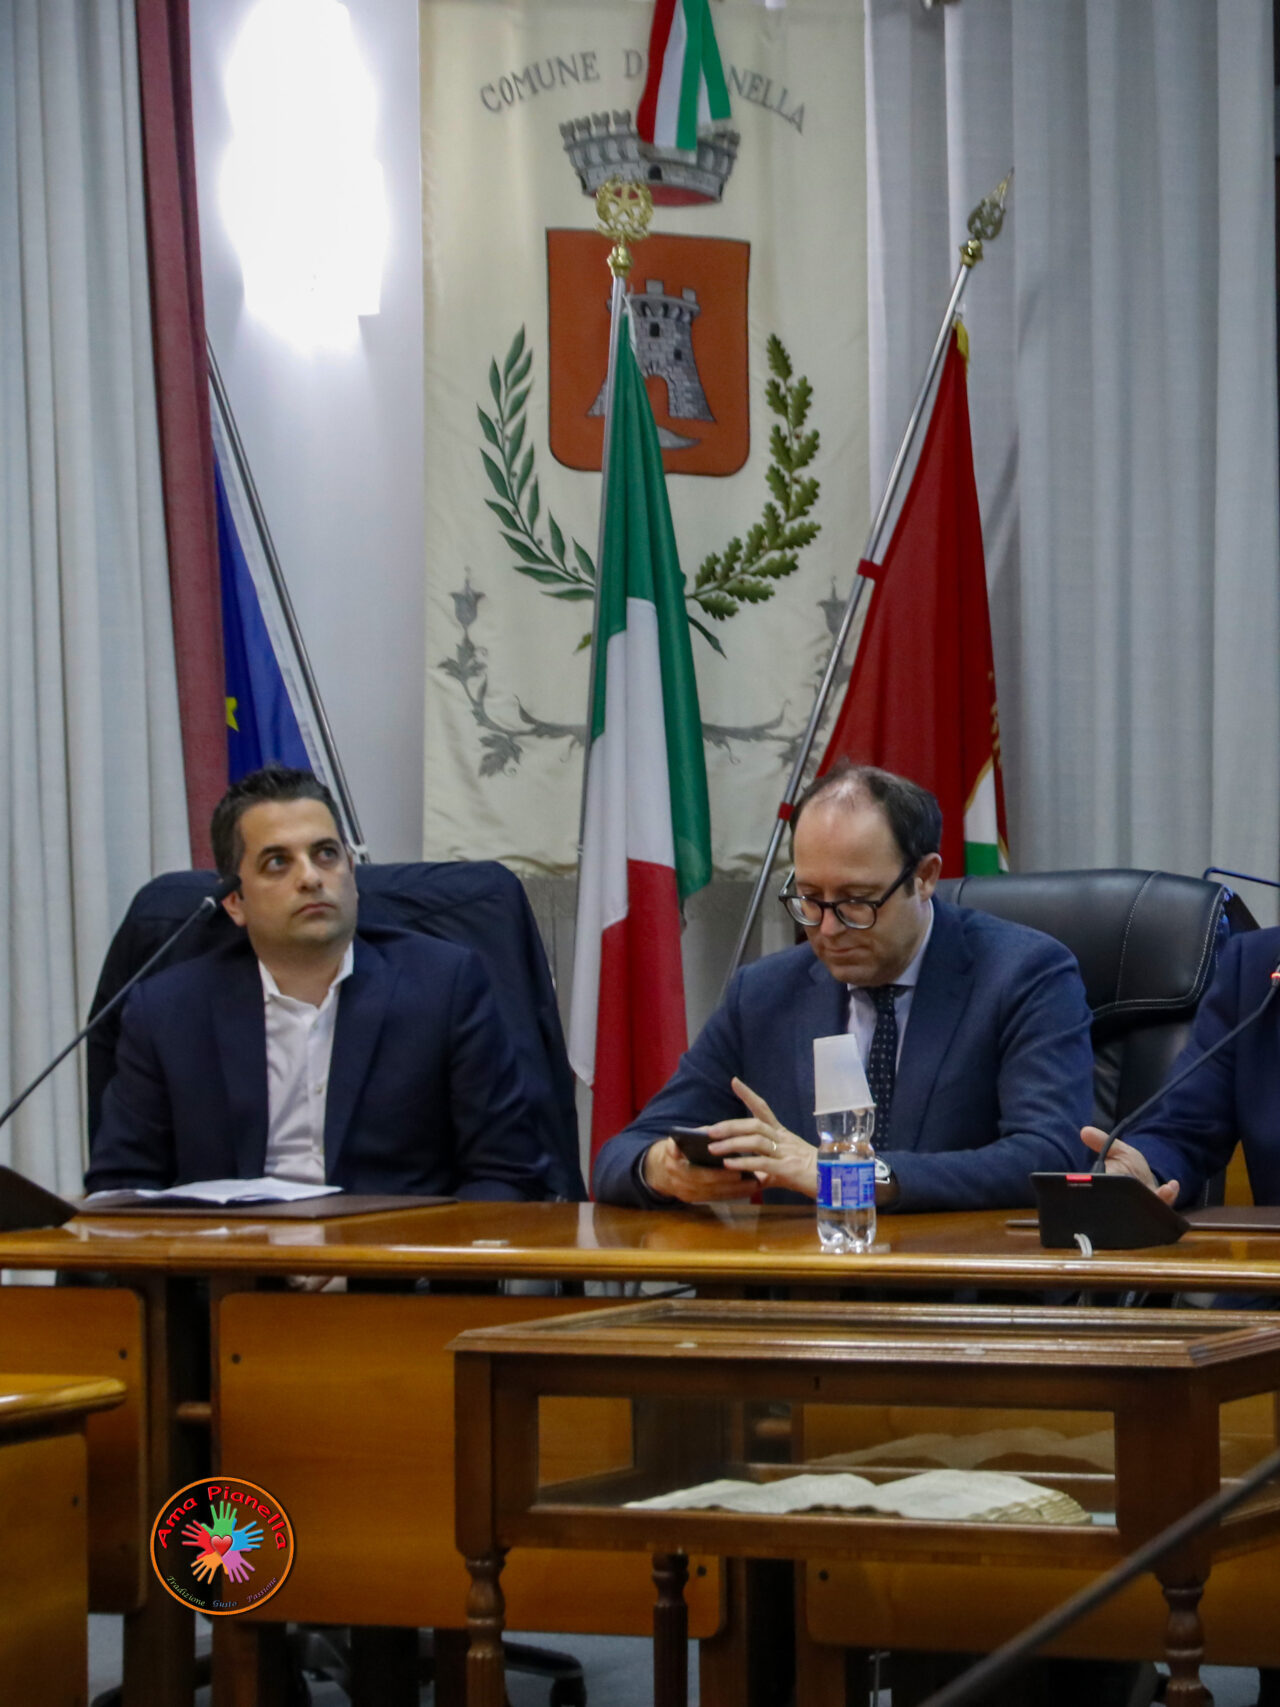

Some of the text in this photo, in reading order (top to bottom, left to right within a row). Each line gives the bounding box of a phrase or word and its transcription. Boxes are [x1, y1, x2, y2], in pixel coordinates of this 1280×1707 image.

[479, 48, 805, 134] COMUNE D NELLA
